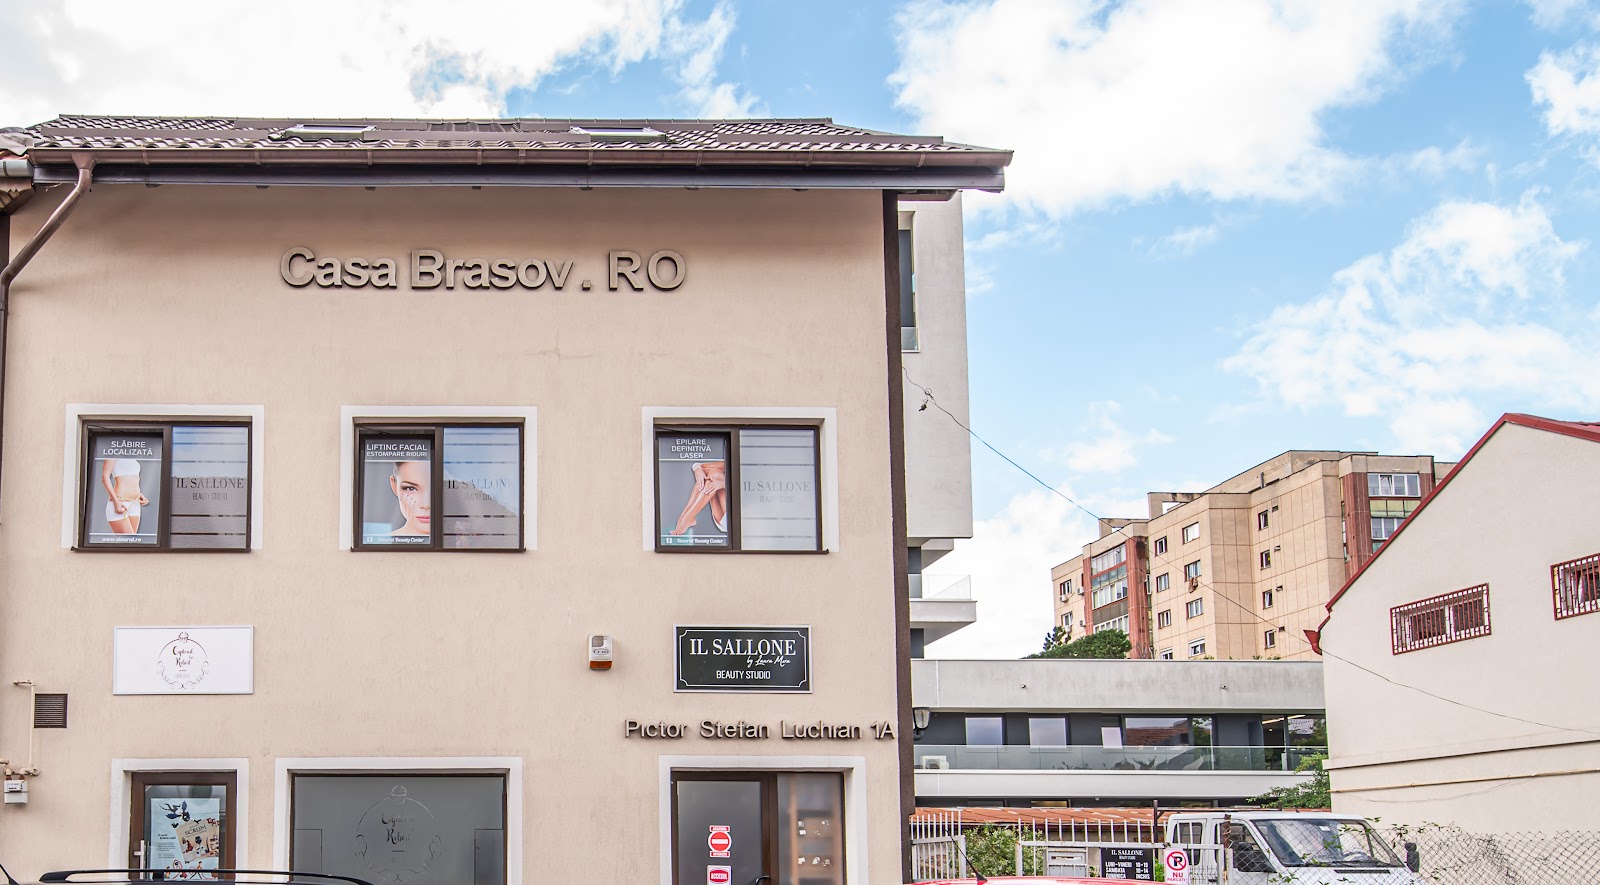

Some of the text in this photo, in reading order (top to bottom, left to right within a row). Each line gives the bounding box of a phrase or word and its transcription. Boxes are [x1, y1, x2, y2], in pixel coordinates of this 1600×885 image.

[280, 247, 398, 289] Casa
[410, 249, 573, 290] Brasov
[176, 478, 245, 489] IL SALLONE
[448, 480, 459, 490] IL
[744, 481, 811, 492] IL SALLONE
[690, 638, 796, 656] IL SALLONE
[746, 656, 753, 668] by
[716, 670, 771, 680] BEAUTY STUDIO
[700, 719, 770, 738] Stefan
[870, 722, 896, 740] 1A
